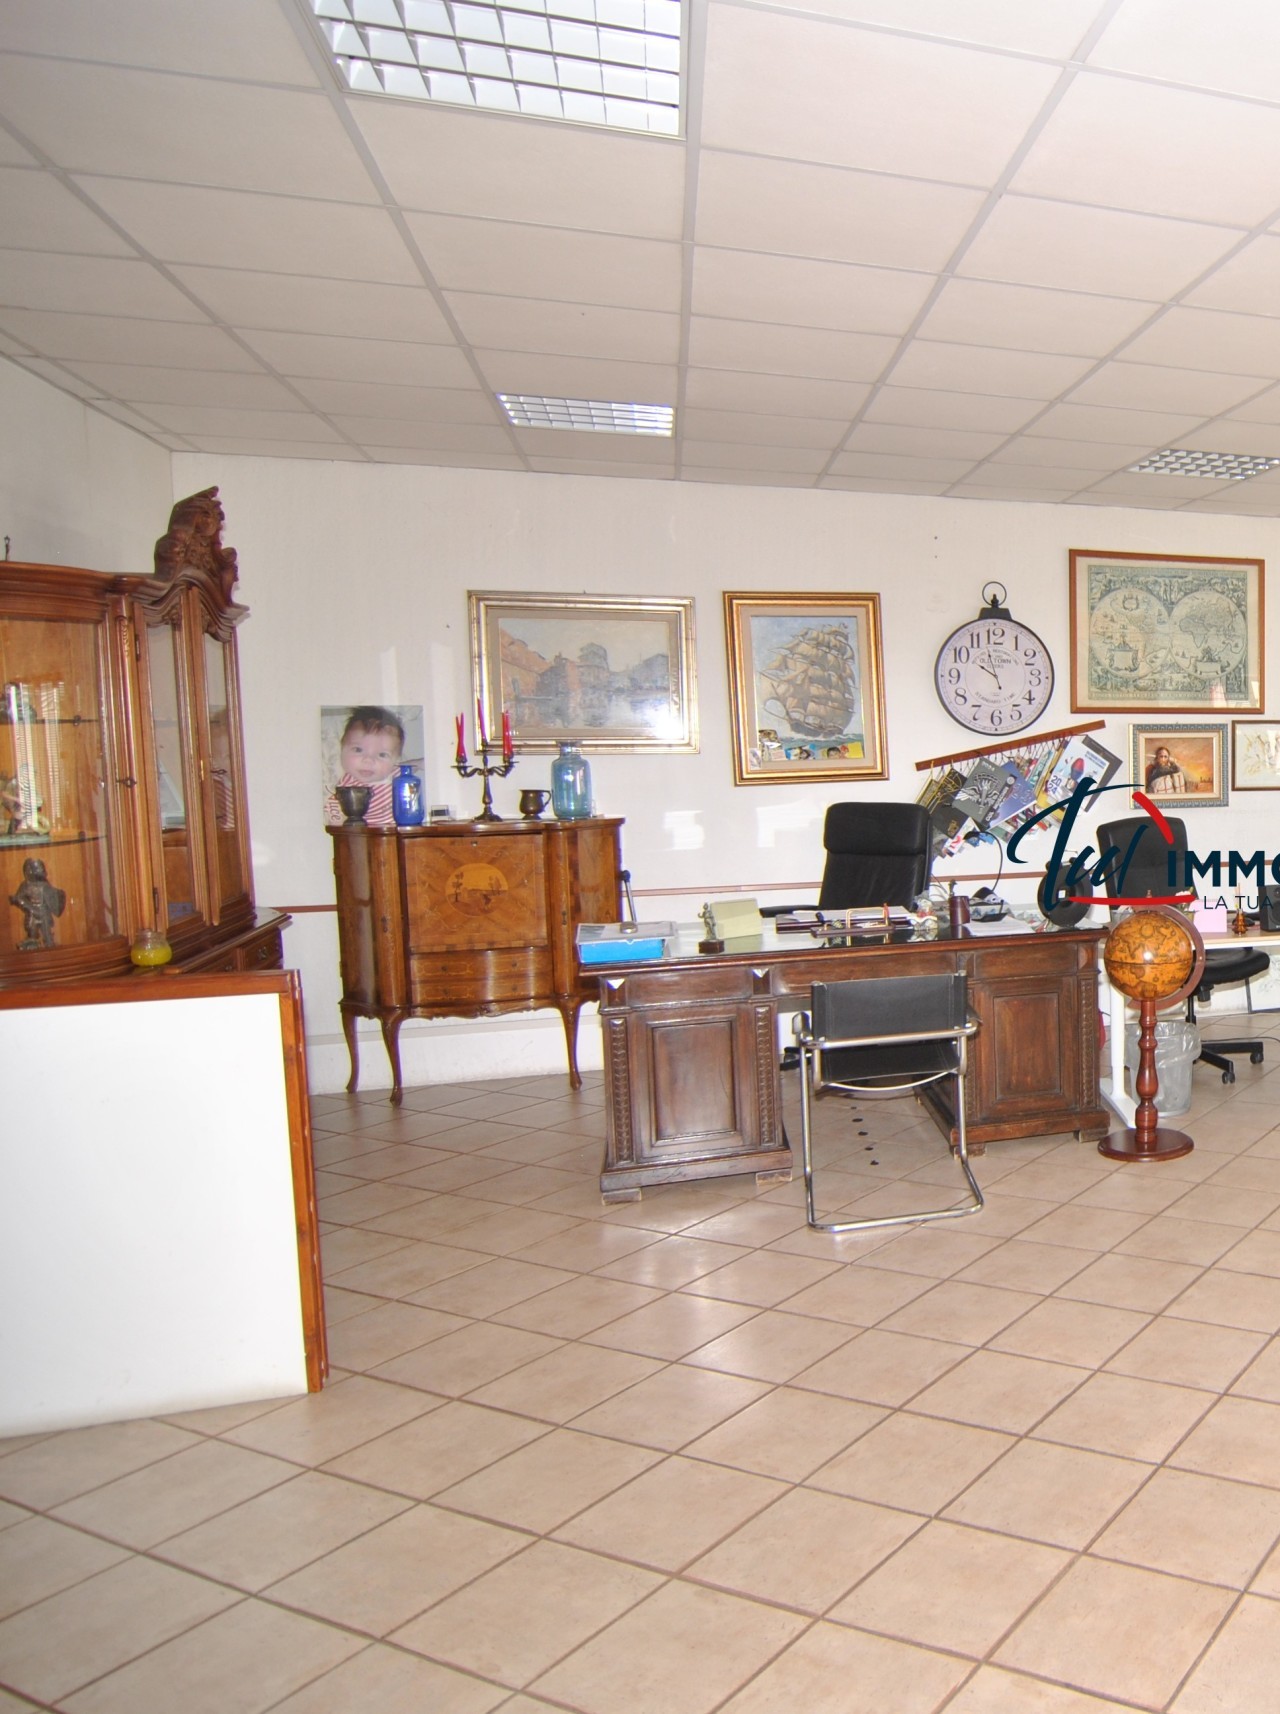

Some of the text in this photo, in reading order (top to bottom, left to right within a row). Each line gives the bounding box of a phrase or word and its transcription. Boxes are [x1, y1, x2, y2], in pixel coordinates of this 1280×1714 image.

[970, 631, 980, 648] 11
[986, 628, 1005, 645] 12
[1014, 634, 1019, 651] 1
[953, 646, 970, 664] 10
[1024, 648, 1036, 666] 2
[948, 668, 960, 685] 9
[1029, 669, 1041, 686] 3
[955, 688, 967, 705] 8
[1022, 690, 1035, 705] 4
[971, 705, 982, 721] 7
[990, 709, 1002, 726] 6
[1010, 704, 1022, 721] 5
